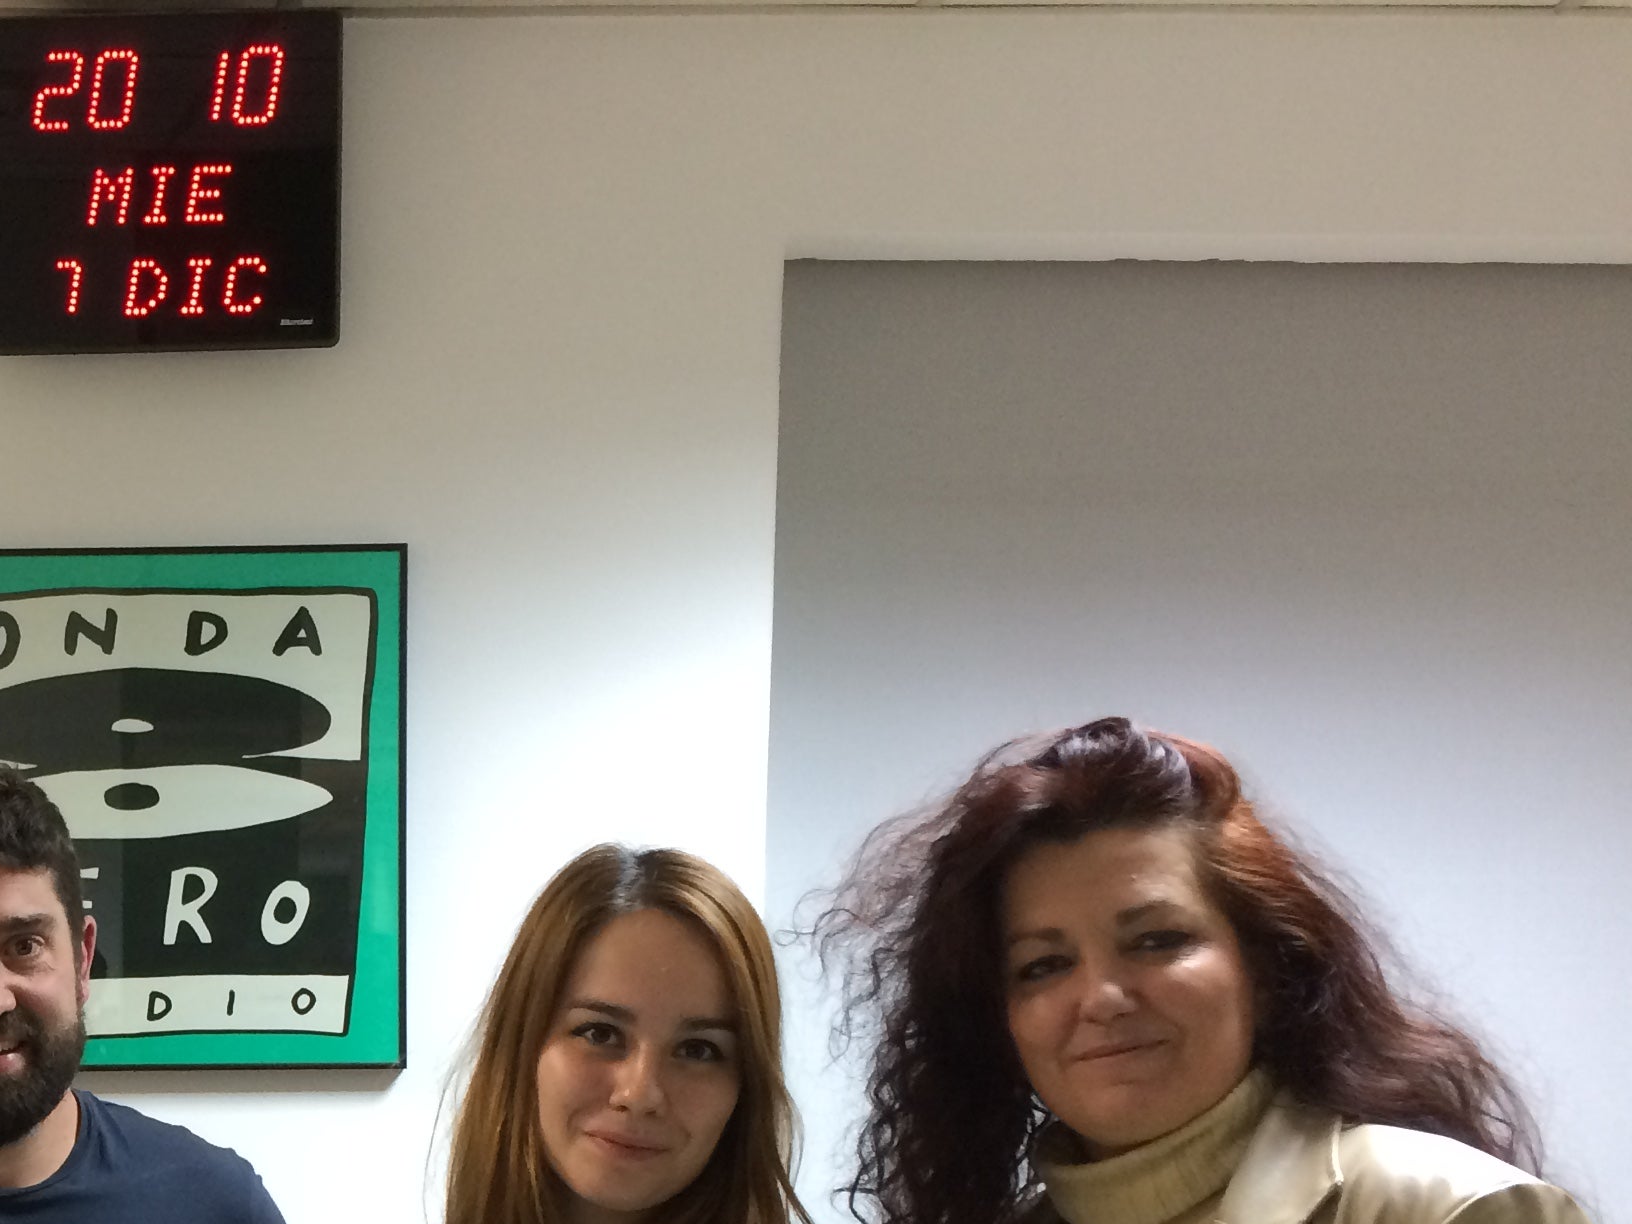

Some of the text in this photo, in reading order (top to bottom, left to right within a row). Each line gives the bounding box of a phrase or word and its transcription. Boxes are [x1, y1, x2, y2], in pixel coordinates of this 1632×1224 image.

[31, 44, 285, 131] 20 10
[87, 165, 233, 226] MIE
[56, 256, 268, 317] 7 DIC
[80, 867, 310, 945] RO
[147, 987, 316, 1021] DIO
